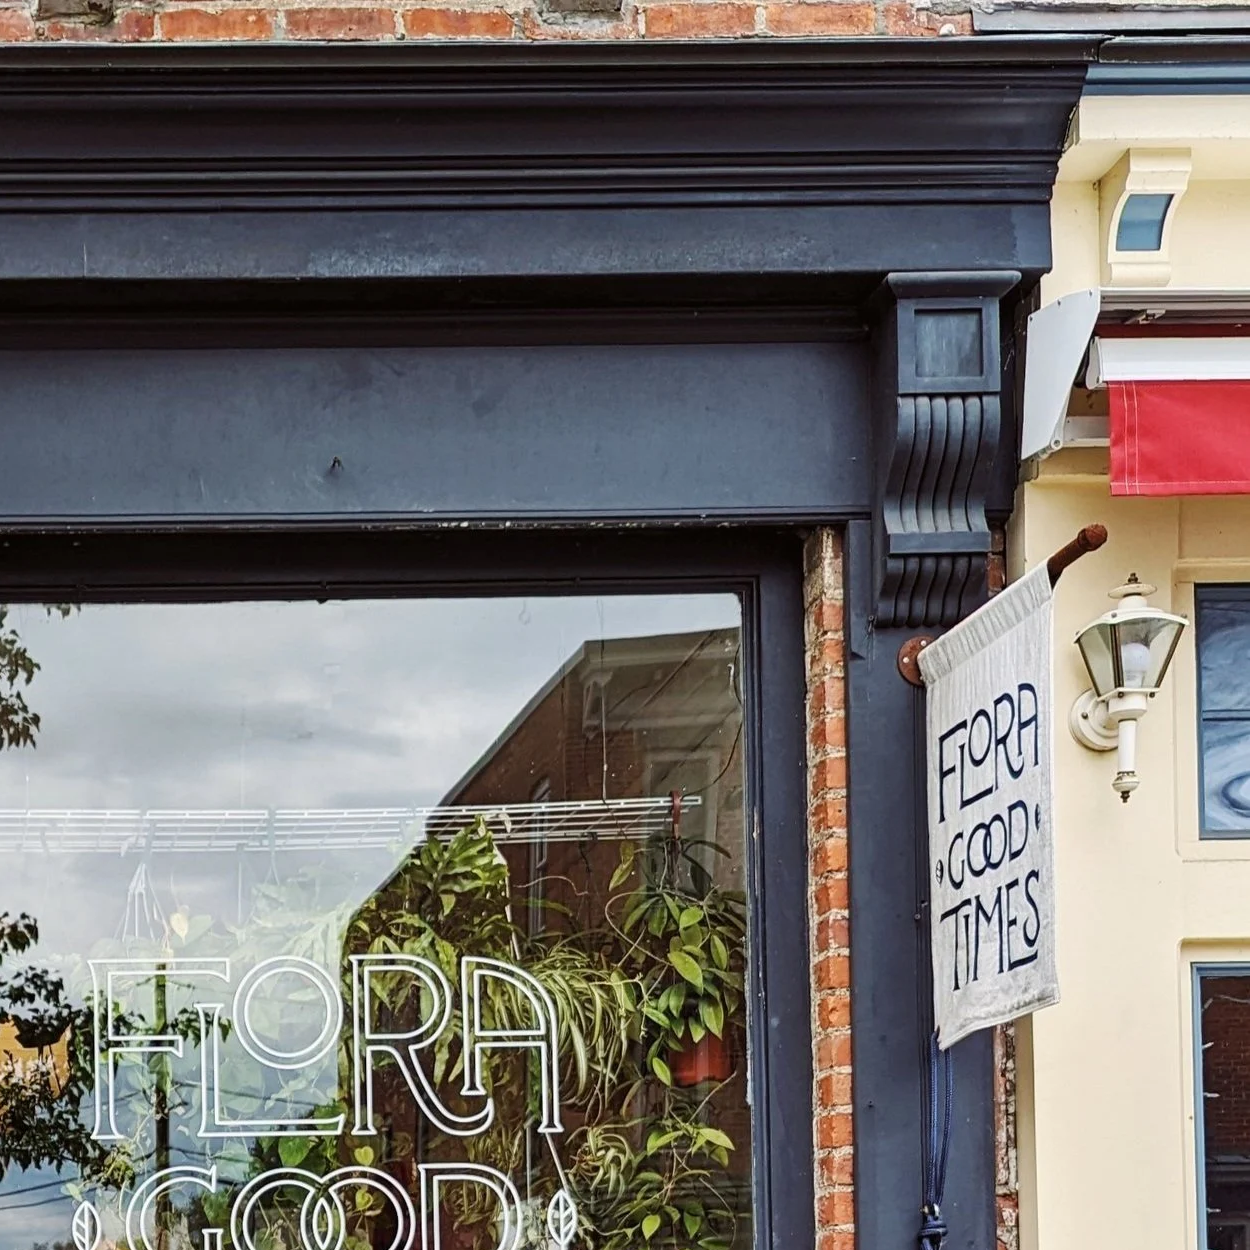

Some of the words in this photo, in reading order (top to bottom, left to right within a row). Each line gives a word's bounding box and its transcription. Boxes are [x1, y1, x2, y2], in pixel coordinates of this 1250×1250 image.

[938, 682, 1039, 823] FLORA
[947, 800, 1029, 889] GOOD
[940, 868, 1040, 992] TIMES
[88, 954, 563, 1139] FLORA
